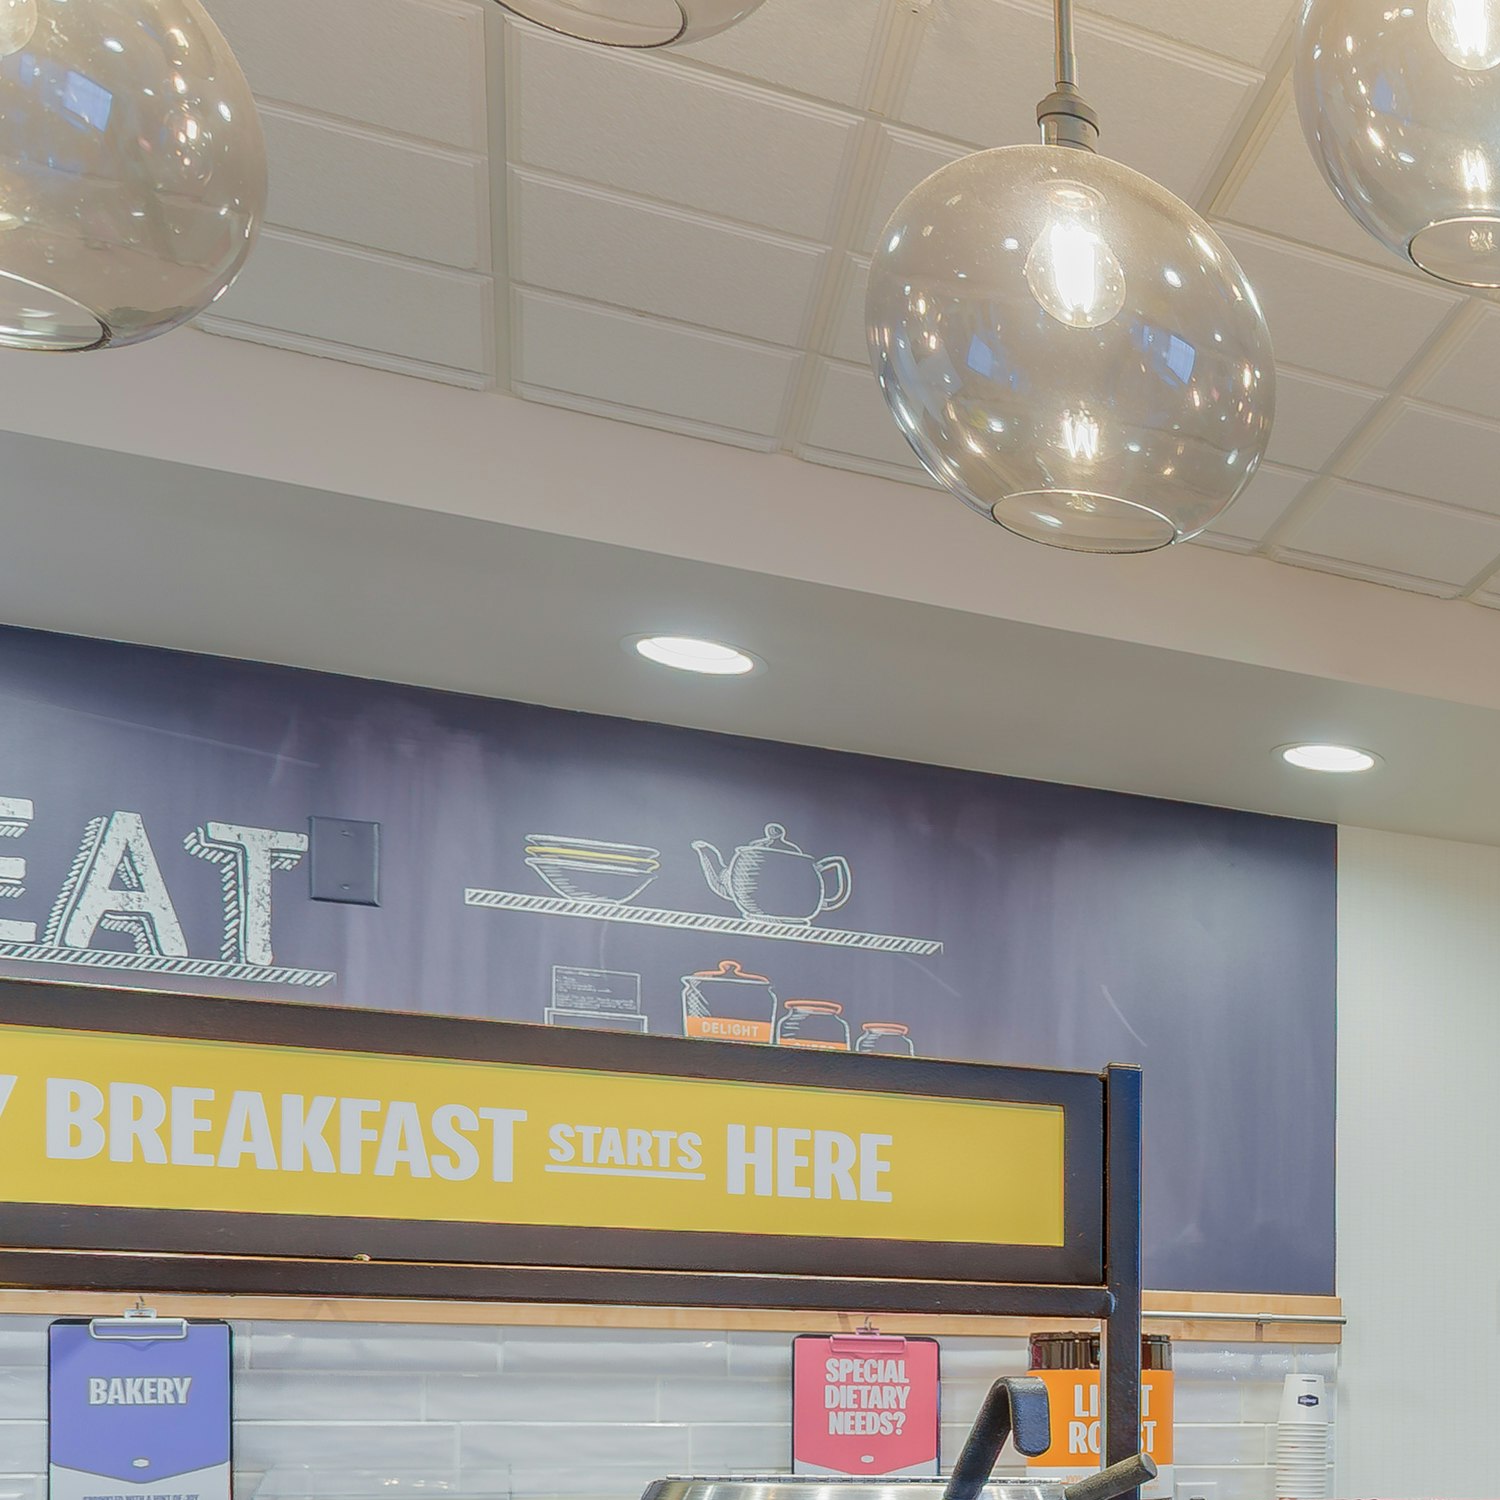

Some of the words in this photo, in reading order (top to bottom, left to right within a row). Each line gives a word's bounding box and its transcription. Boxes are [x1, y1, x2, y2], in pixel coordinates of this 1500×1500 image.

[701, 1021, 760, 1038] DELIGHT
[46, 1077, 527, 1183] BREAKFAST
[548, 1123, 703, 1169] STARTS
[727, 1124, 893, 1203] HERE
[825, 1358, 910, 1383] SPECIAL
[88, 1377, 192, 1405] BAKERY
[824, 1385, 911, 1409] DIETARY
[1074, 1384, 1153, 1417] LIT
[828, 1411, 906, 1435] NEEDS?
[1068, 1420, 1157, 1454] ROT
